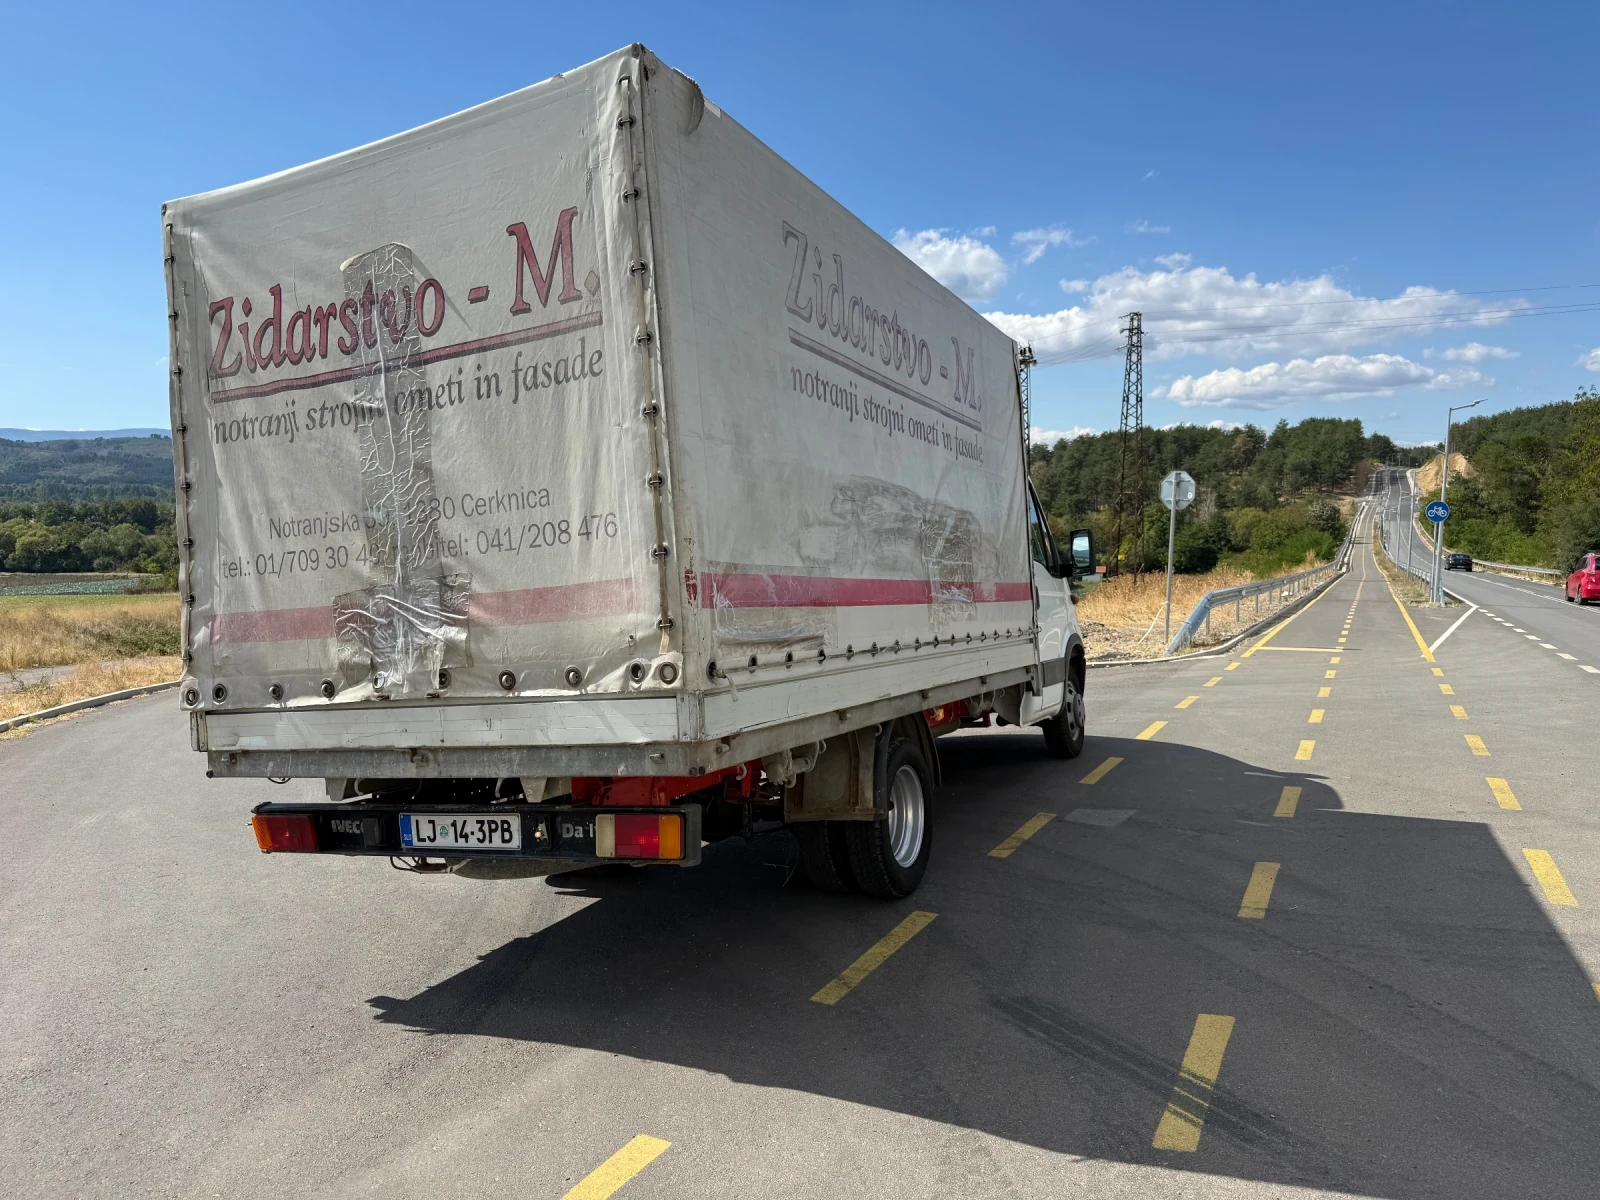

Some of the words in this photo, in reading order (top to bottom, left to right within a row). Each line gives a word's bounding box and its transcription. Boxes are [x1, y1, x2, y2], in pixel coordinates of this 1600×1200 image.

[208, 278, 445, 380] Zidarstvo
[467, 285, 490, 304] -
[782, 220, 932, 386] Zidarstvo
[939, 365, 949, 380] -
[212, 400, 300, 444] notranji
[394, 367, 465, 416] ometi
[475, 363, 503, 399] in
[512, 338, 603, 405] fasade
[790, 366, 860, 424] notranji
[863, 394, 905, 437] strojni
[908, 416, 940, 448] ometi
[942, 422, 953, 452] in
[954, 426, 984, 466] fasade
[255, 551, 320, 579] 01/709
[325, 545, 349, 569] 30
[476, 520, 572, 556] 041/208
[577, 511, 619, 541] 476
[268, 507, 361, 540] Notranjska
[461, 487, 551, 518] Cerknica
[331, 819, 364, 834] IVEC
[415, 819, 437, 843] LJ
